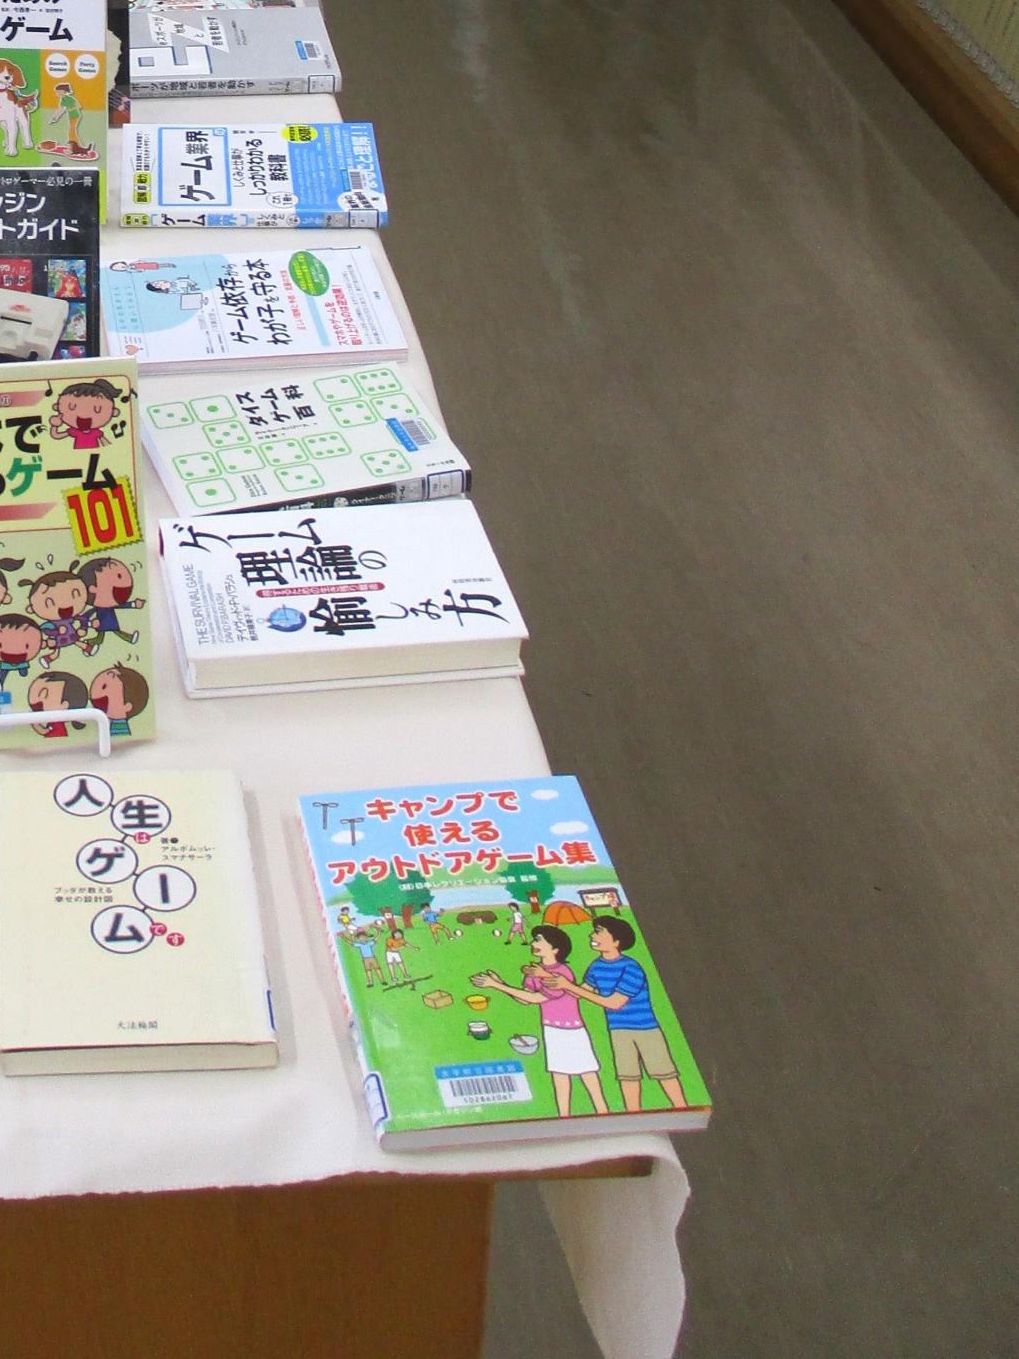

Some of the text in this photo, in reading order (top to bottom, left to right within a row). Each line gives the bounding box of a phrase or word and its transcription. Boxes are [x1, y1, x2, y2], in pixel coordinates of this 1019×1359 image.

[181, 130, 216, 201] ゲーム業界
[231, 148, 245, 188] しくみと仕事が
[245, 138, 267, 196] しっかりわかる
[268, 154, 289, 182] 教科書
[215, 263, 257, 345] ゲーム依存から
[243, 258, 293, 346] わが子を守る本
[236, 391, 269, 427] ダイス
[261, 387, 291, 423] ゲーム
[281, 384, 317, 420] 百科
[69, 484, 134, 547] 101
[173, 518, 322, 552] ゲーム
[235, 545, 388, 587] 理論の
[309, 589, 509, 636] 愉しみ方
[366, 790, 519, 820] キャンプで
[403, 819, 501, 847] 使える
[327, 840, 597, 884] アウトドアゲーム集
